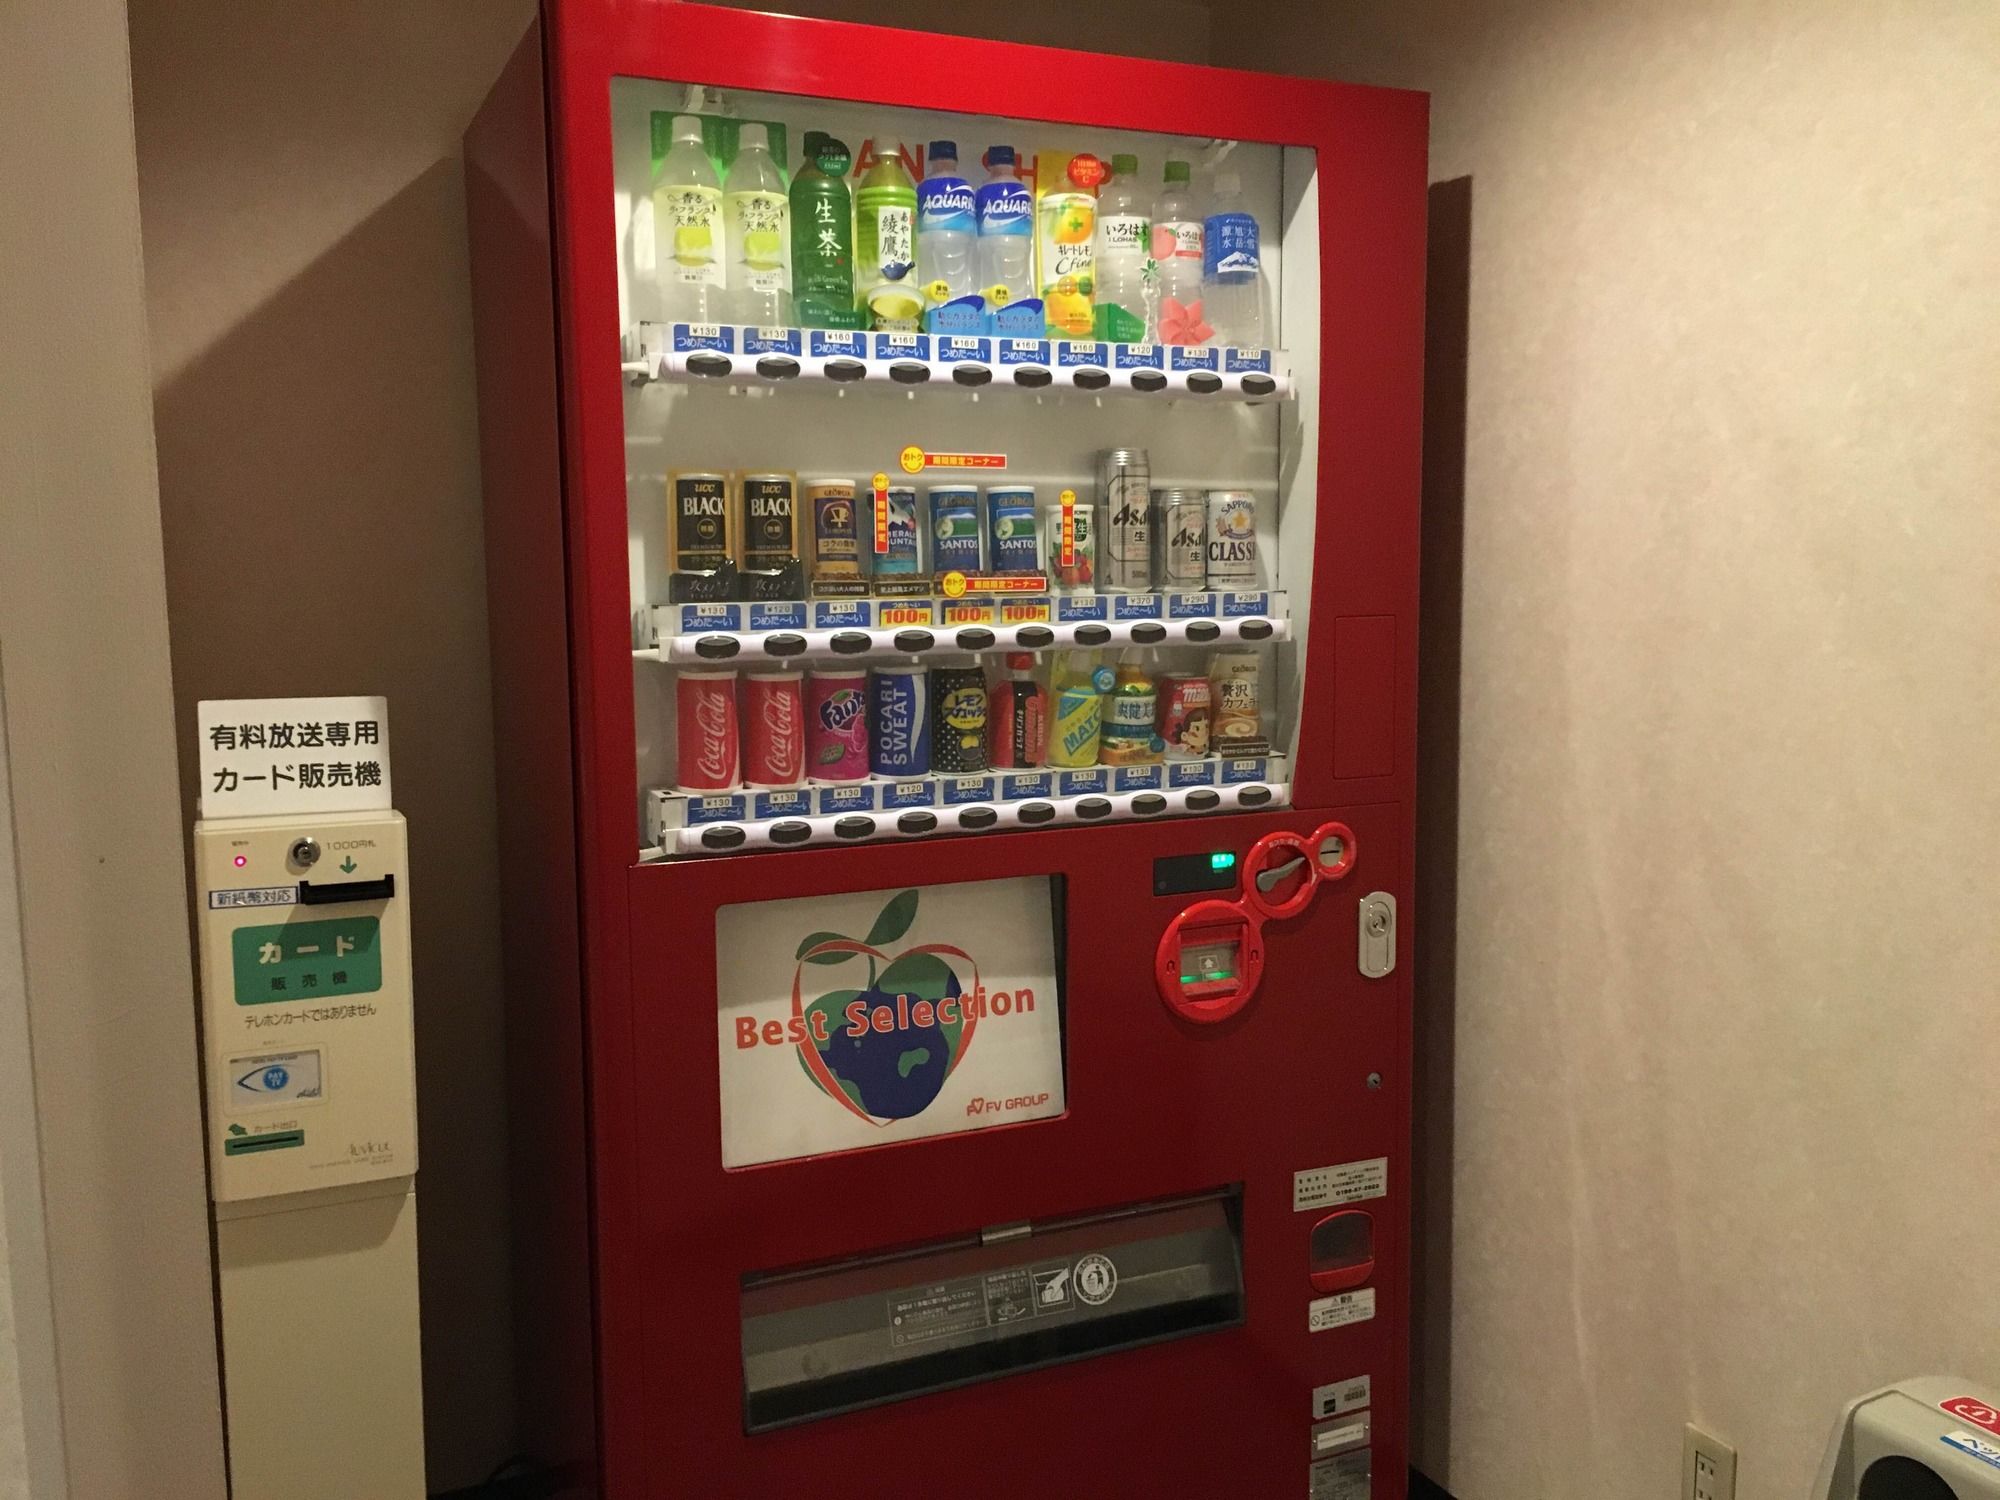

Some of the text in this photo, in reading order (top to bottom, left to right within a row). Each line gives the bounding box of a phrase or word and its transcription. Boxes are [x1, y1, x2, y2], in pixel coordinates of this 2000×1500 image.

[674, 215, 711, 227] 天然水
[744, 221, 780, 233] 天然水
[815, 198, 842, 257] 生茶
[881, 213, 900, 257] 綾鷹
[899, 211, 910, 261] あやたか
[692, 326, 717, 336] ¥130
[762, 329, 786, 339] ¥130
[683, 497, 725, 516] BLACK
[751, 498, 792, 516] BLACK
[1134, 531, 1145, 542] 生
[1190, 551, 1200, 562] 生
[701, 607, 725, 615] ¥130
[832, 604, 855, 612] ¥130
[948, 607, 992, 622] 100円
[1005, 605, 1047, 620] 100円
[884, 609, 928, 624] 100円
[880, 680, 893, 765] POCARI
[893, 688, 907, 765] SWEAT
[209, 721, 379, 751] 有料放送専用
[213, 761, 382, 793] カード販売機
[960, 780, 982, 788] ¥130
[1017, 776, 1038, 784] ¥130
[836, 789, 859, 797] ¥130
[900, 785, 922, 793] ¥120
[706, 798, 730, 806] ¥130
[773, 793, 796, 801] ¥130
[217, 889, 291, 905] 新紙幣対応
[258, 935, 355, 964] カード
[271, 971, 348, 991] 販売機
[244, 1003, 377, 1029] テレホンカードではありません
[735, 985, 1036, 1050] Best Selection
[986, 1093, 1050, 1113] FV GROUP
